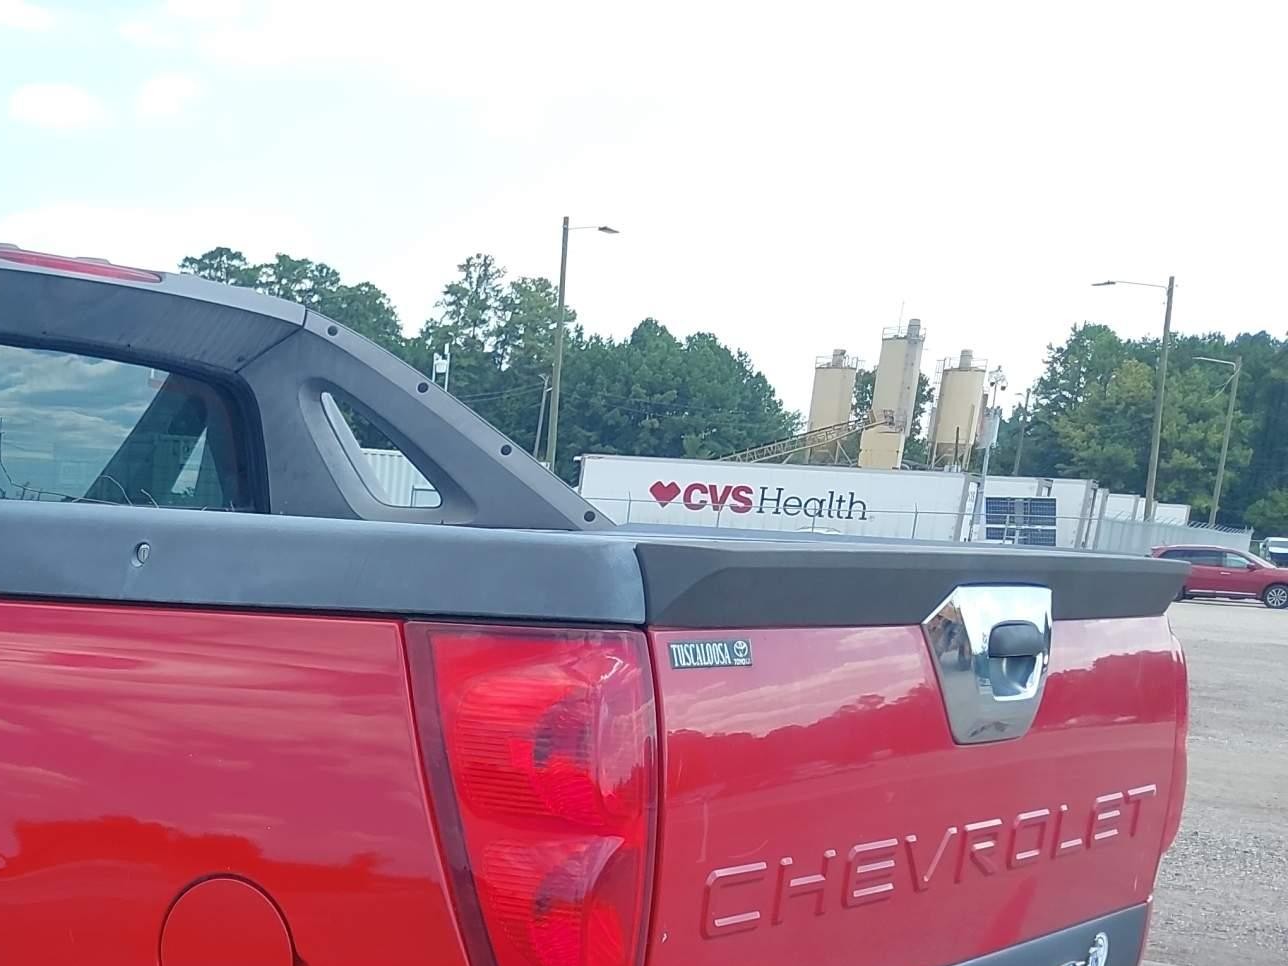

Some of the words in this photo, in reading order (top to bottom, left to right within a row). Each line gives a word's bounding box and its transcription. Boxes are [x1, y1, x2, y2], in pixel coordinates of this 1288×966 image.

[683, 482, 754, 513] CVS
[756, 486, 868, 520] Health
[670, 643, 731, 667] TUSCALOOSA
[699, 784, 1157, 941] CHEVROLET
